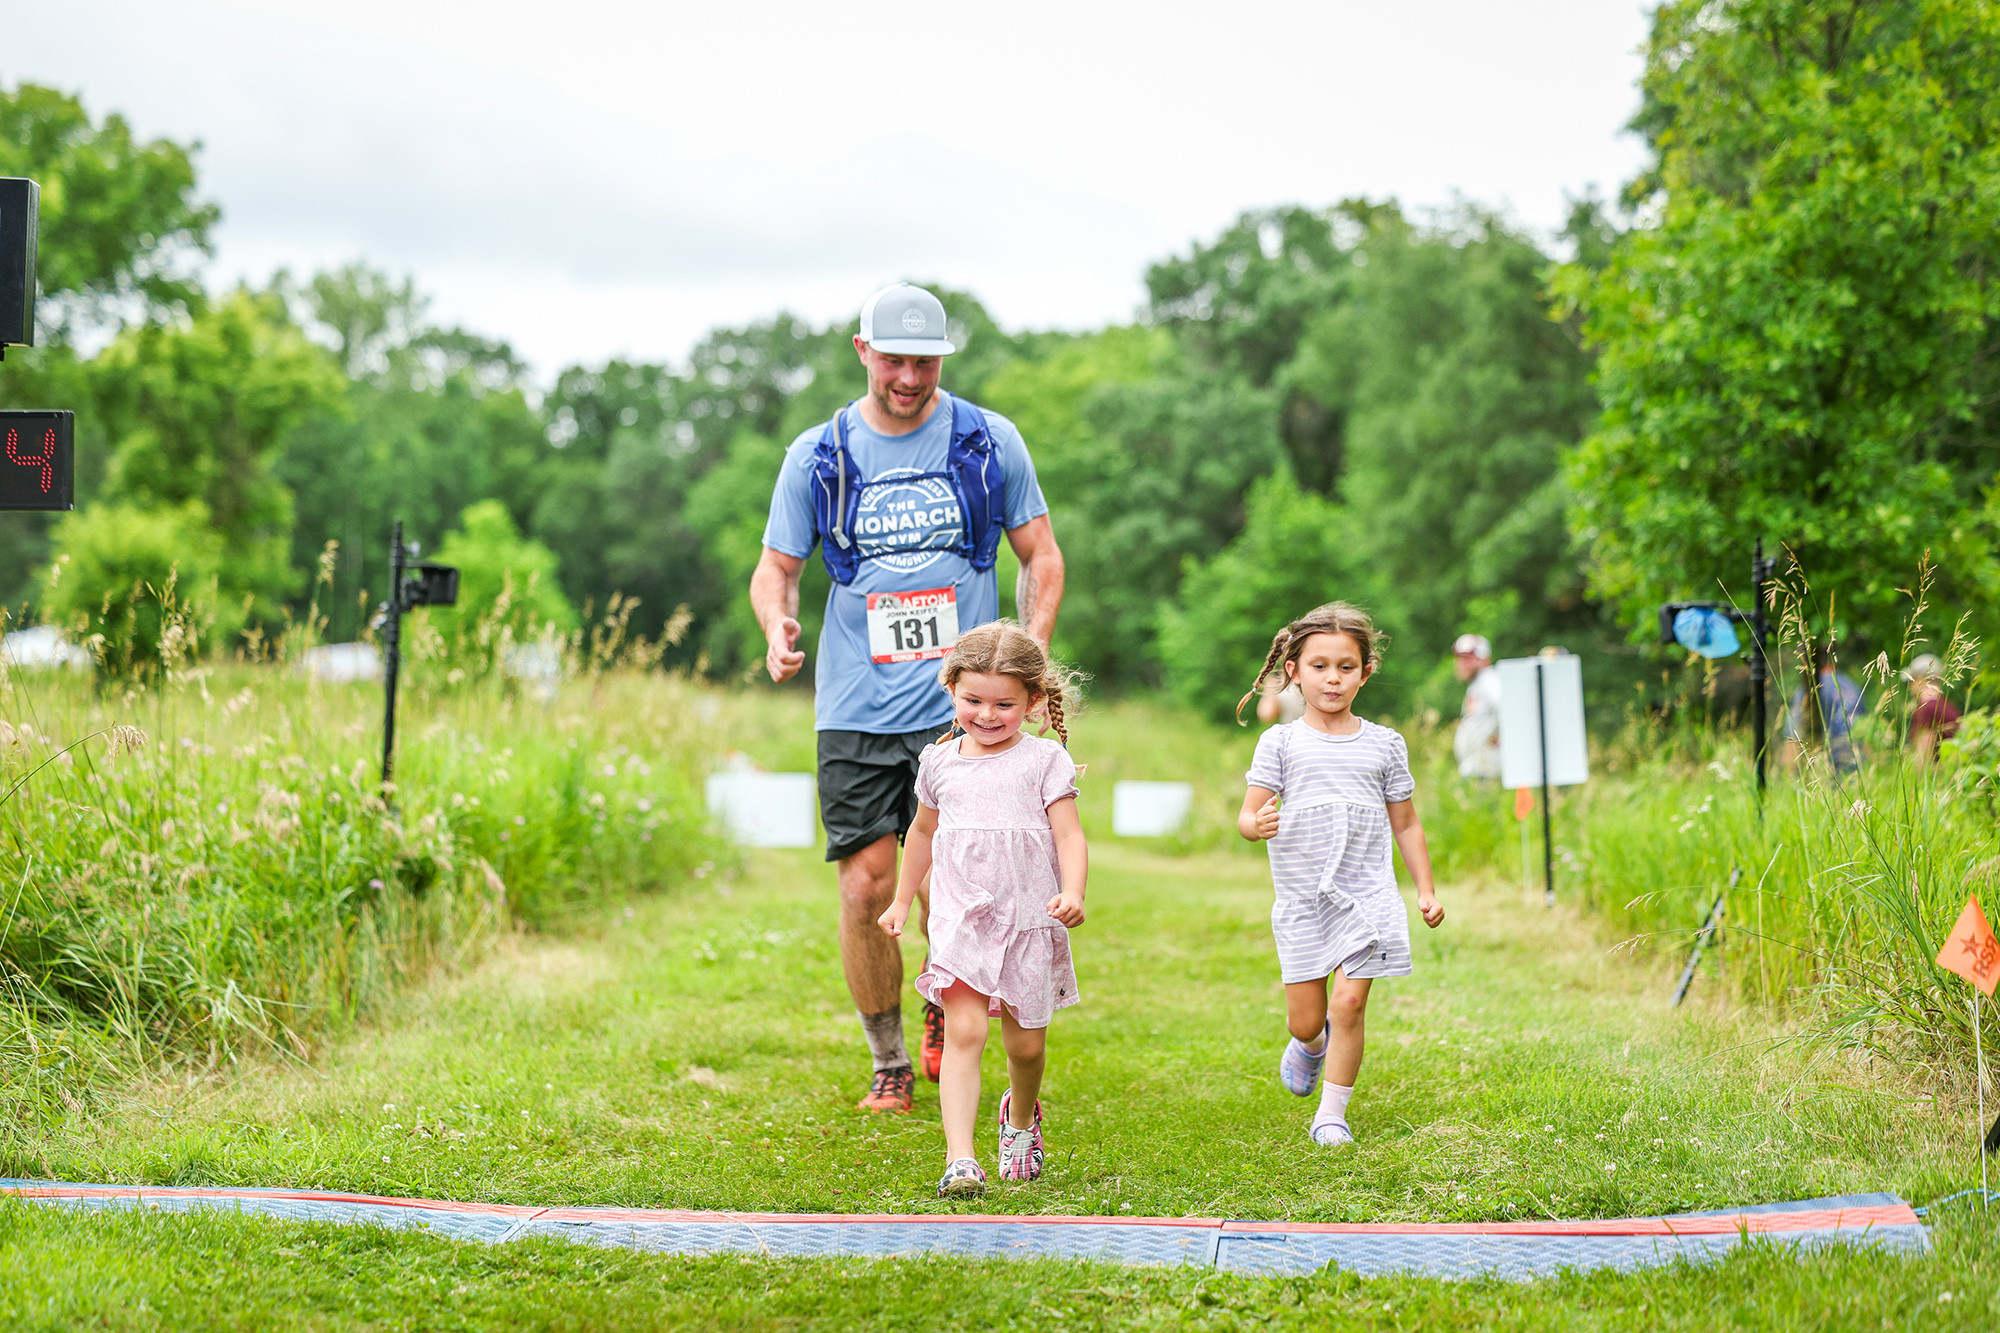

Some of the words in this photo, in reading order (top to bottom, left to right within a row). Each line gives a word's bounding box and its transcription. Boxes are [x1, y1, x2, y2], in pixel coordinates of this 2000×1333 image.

[6, 428, 56, 493] 4
[887, 500, 916, 513] THE
[886, 532, 921, 546] GYM
[873, 547, 935, 567] CMMUNIT
[903, 593, 948, 609] AFTON
[888, 616, 939, 650] 131
